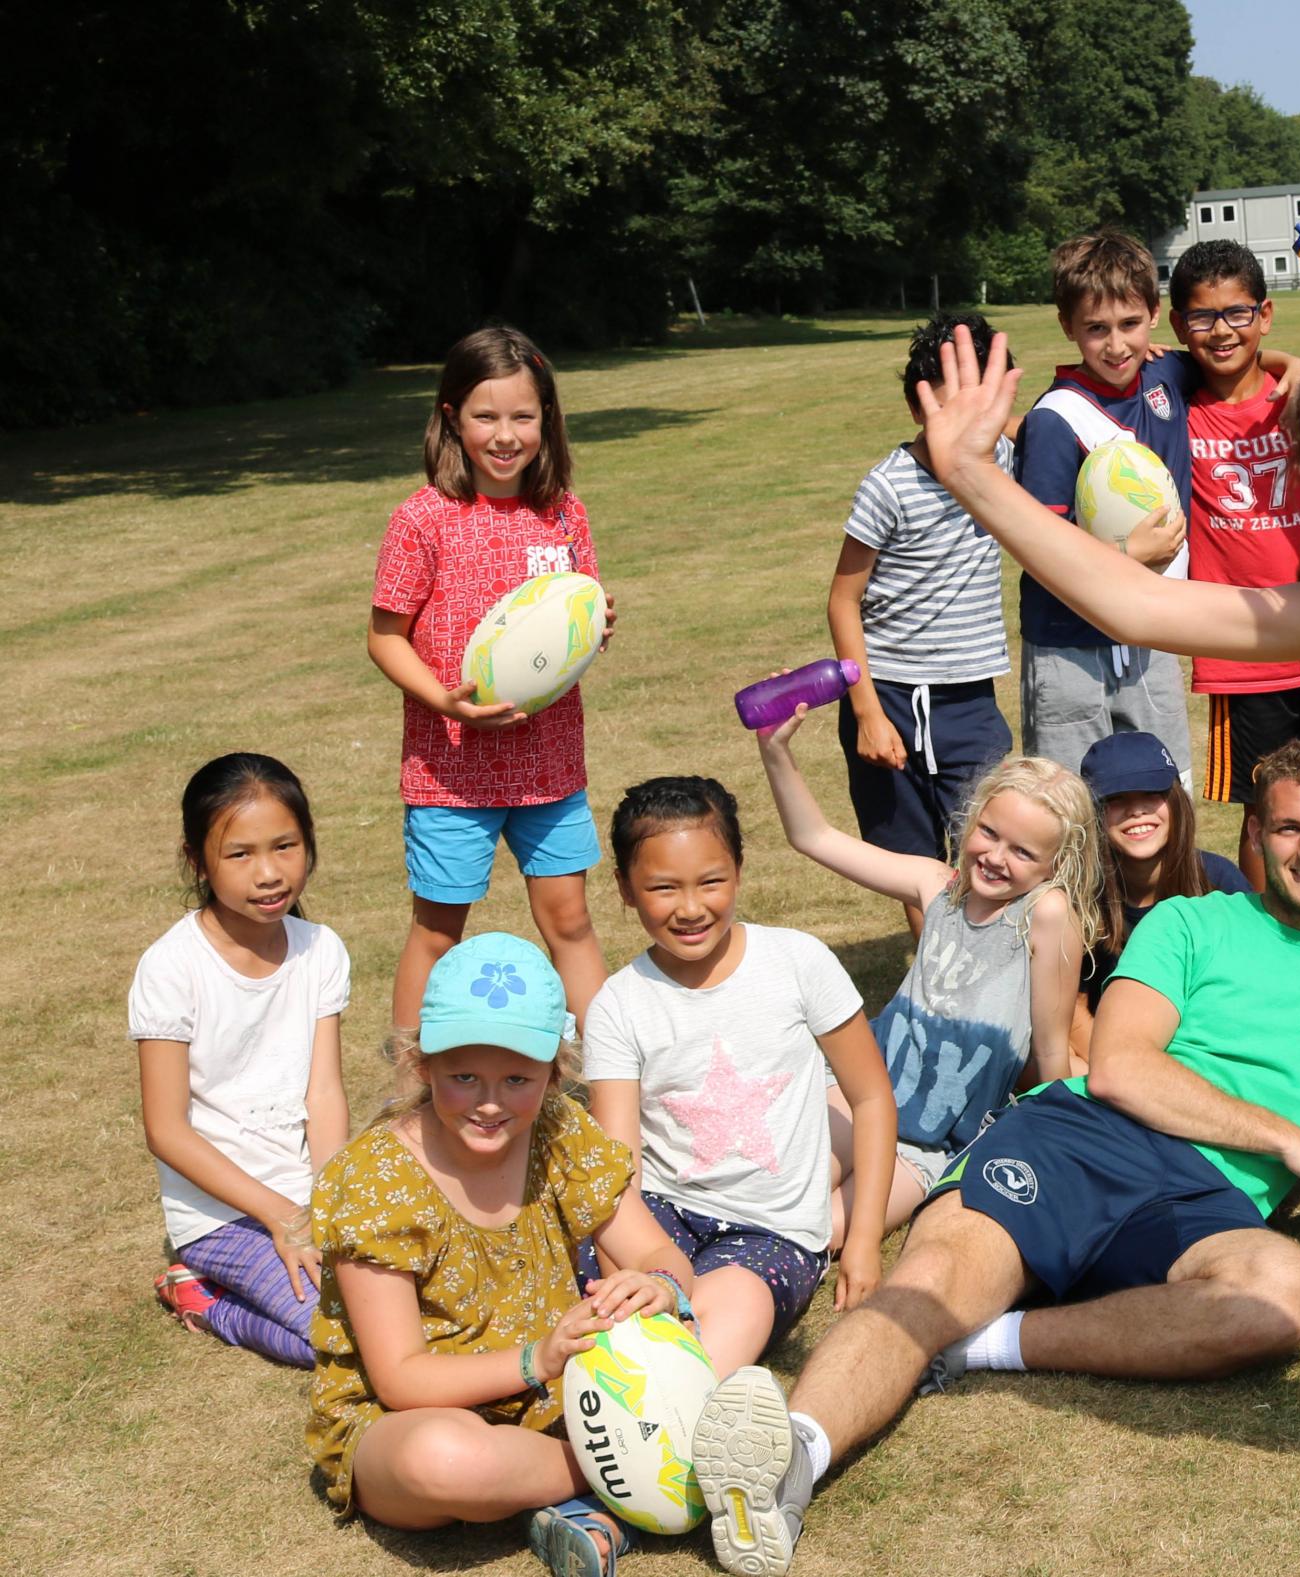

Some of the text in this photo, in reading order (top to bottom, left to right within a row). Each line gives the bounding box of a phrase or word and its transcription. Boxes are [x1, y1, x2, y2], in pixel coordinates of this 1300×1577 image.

[1211, 455, 1288, 512] 37
[1209, 515, 1245, 531] NEW
[527, 545, 571, 562] SPOR
[527, 560, 573, 577] RELIE
[579, 1389, 632, 1498] mitre
